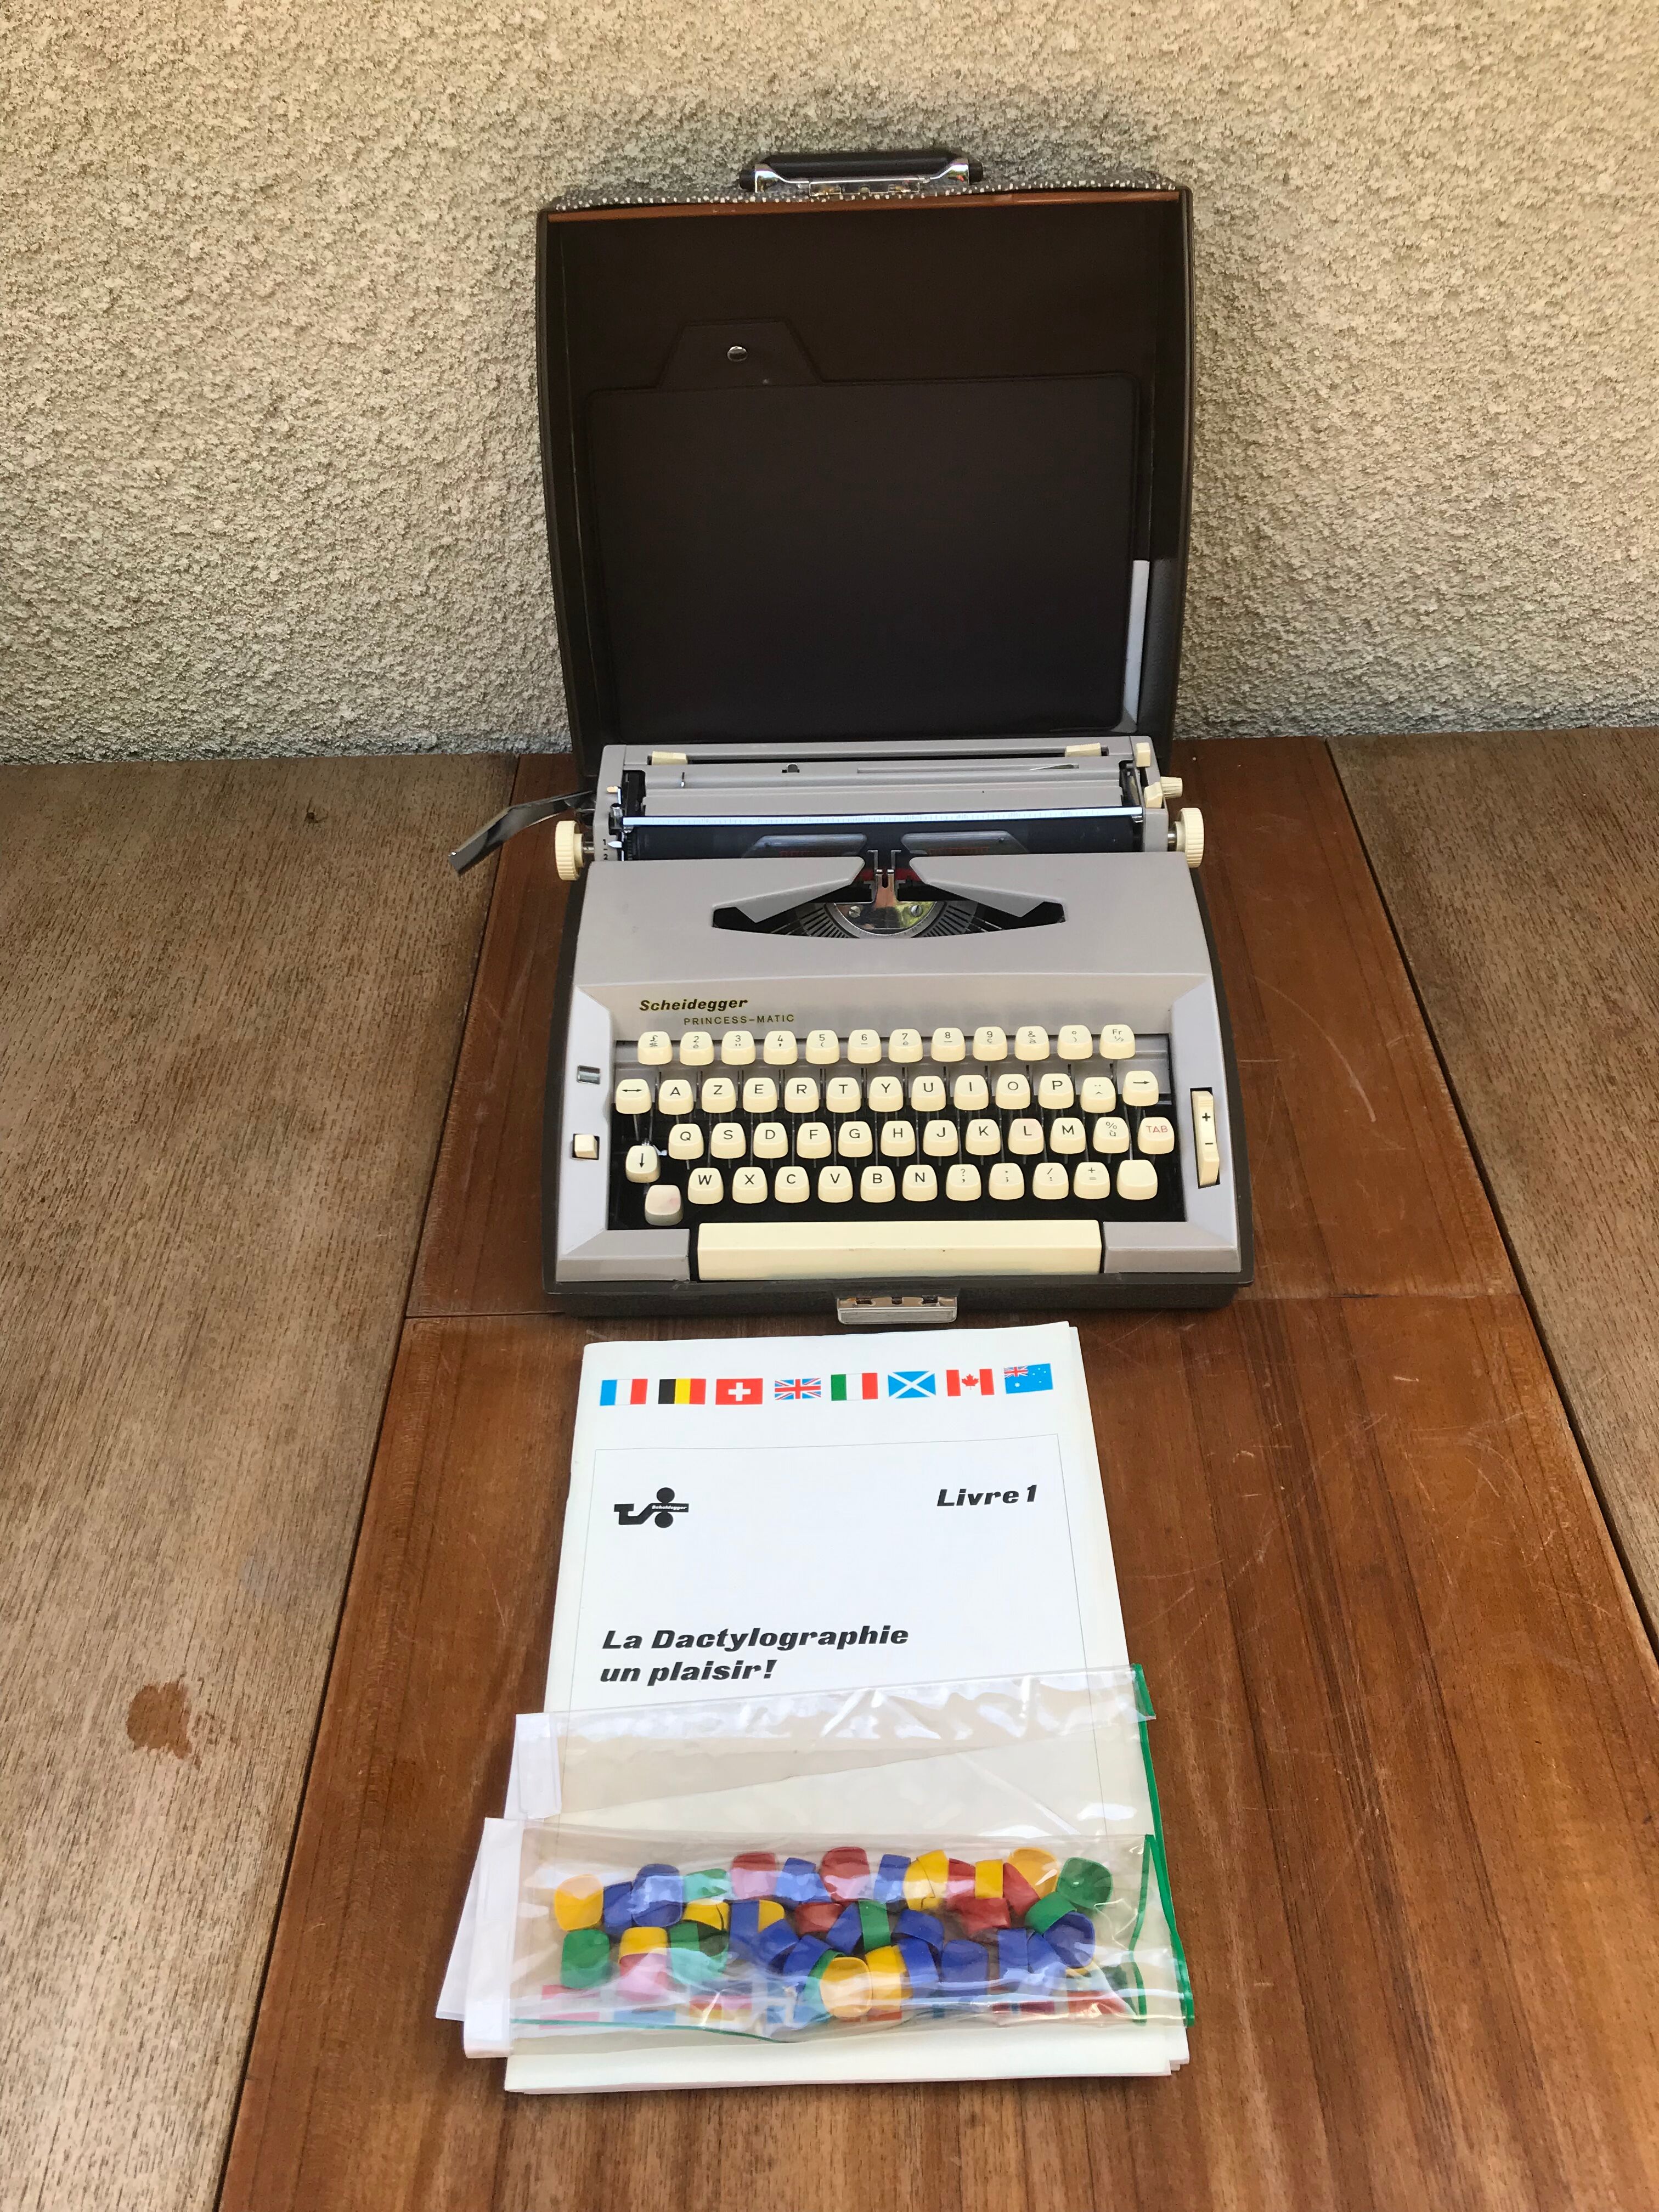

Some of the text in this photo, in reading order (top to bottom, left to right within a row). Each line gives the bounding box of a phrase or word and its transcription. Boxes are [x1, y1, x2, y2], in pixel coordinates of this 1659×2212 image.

[639, 998, 748, 1012] Scheidegger
[684, 1014, 794, 1025] PRINCESS-MATIC
[713, 1085, 723, 1095] Z
[754, 1084, 764, 1094] E
[797, 1084, 807, 1094] R
[838, 1084, 848, 1094] T
[881, 1083, 891, 1093] Y
[923, 1082, 934, 1092] U
[969, 1081, 972, 1092] I
[1007, 1081, 1019, 1091] O
[1052, 1080, 1063, 1090] P
[670, 1086, 681, 1096] A
[1023, 1125, 1032, 1136] L
[1062, 1125, 1074, 1135] M
[1105, 1121, 1118, 1130] %
[1146, 1125, 1168, 1133] TAB
[680, 1131, 691, 1141] Q
[724, 1130, 733, 1140] S
[765, 1129, 776, 1139] D
[809, 1129, 819, 1139] F
[849, 1128, 860, 1139] G
[893, 1127, 903, 1138] H
[936, 1127, 946, 1137] J
[979, 1126, 989, 1136] K
[698, 1175, 712, 1186] W
[744, 1174, 755, 1185] X
[786, 1173, 796, 1184] C
[830, 1173, 840, 1184] V
[873, 1173, 883, 1184] B
[915, 1172, 925, 1183] N
[936, 1485, 1037, 1506] Livre 1
[602, 1625, 909, 1652] La Dactylographie
[600, 1659, 777, 1686] un plaisir!
